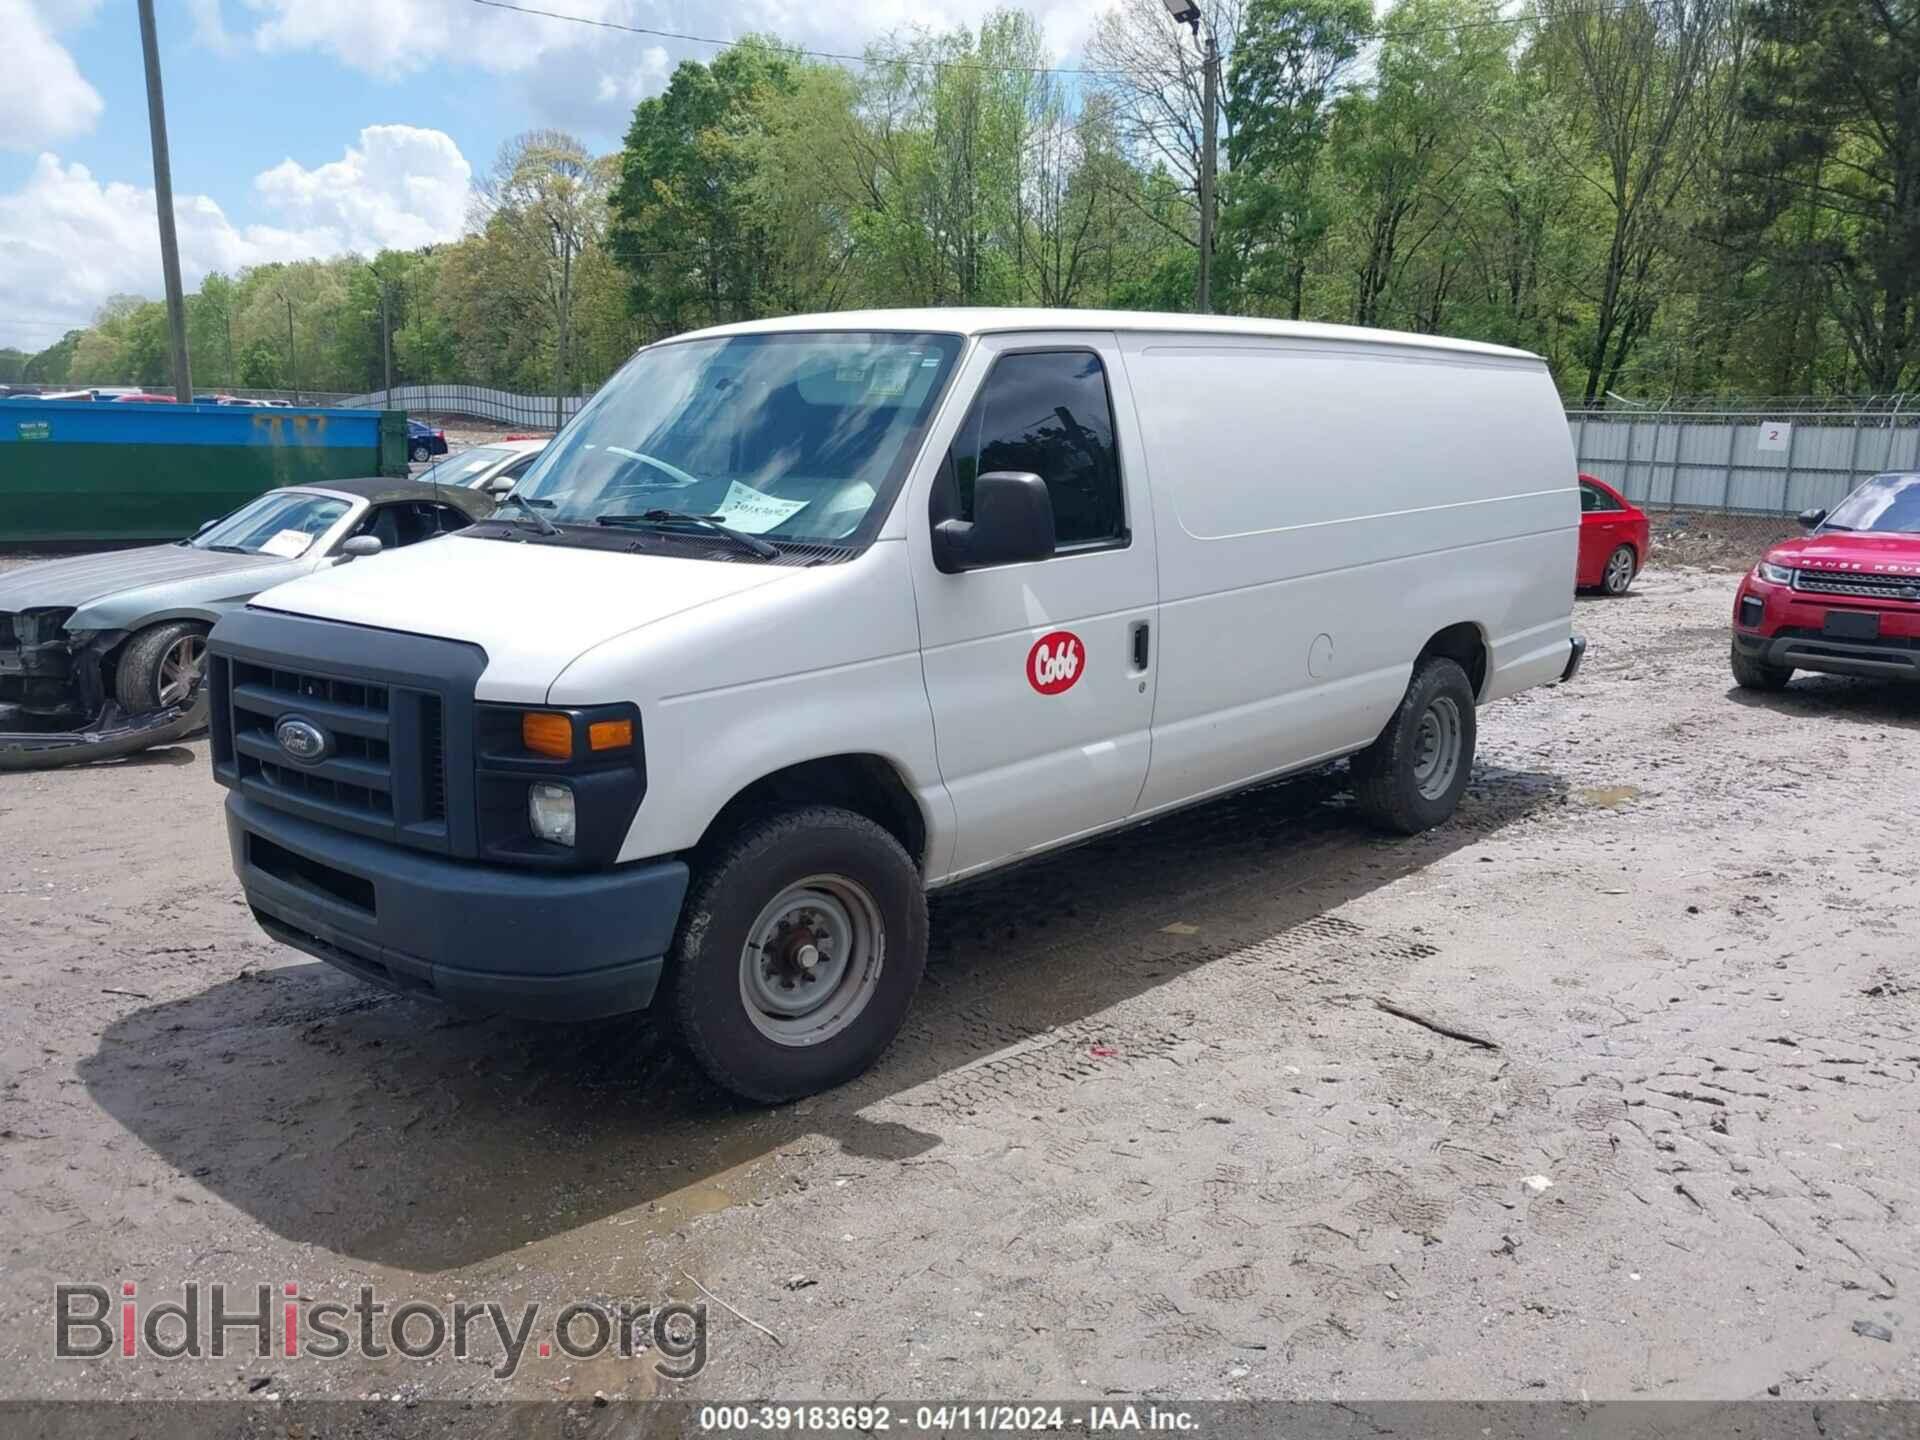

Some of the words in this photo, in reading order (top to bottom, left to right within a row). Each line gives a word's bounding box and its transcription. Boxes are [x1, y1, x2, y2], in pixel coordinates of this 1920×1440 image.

[1769, 431, 1778, 440] 2
[1802, 560, 1862, 570] RANGE
[1035, 639, 1078, 685] Cobb
